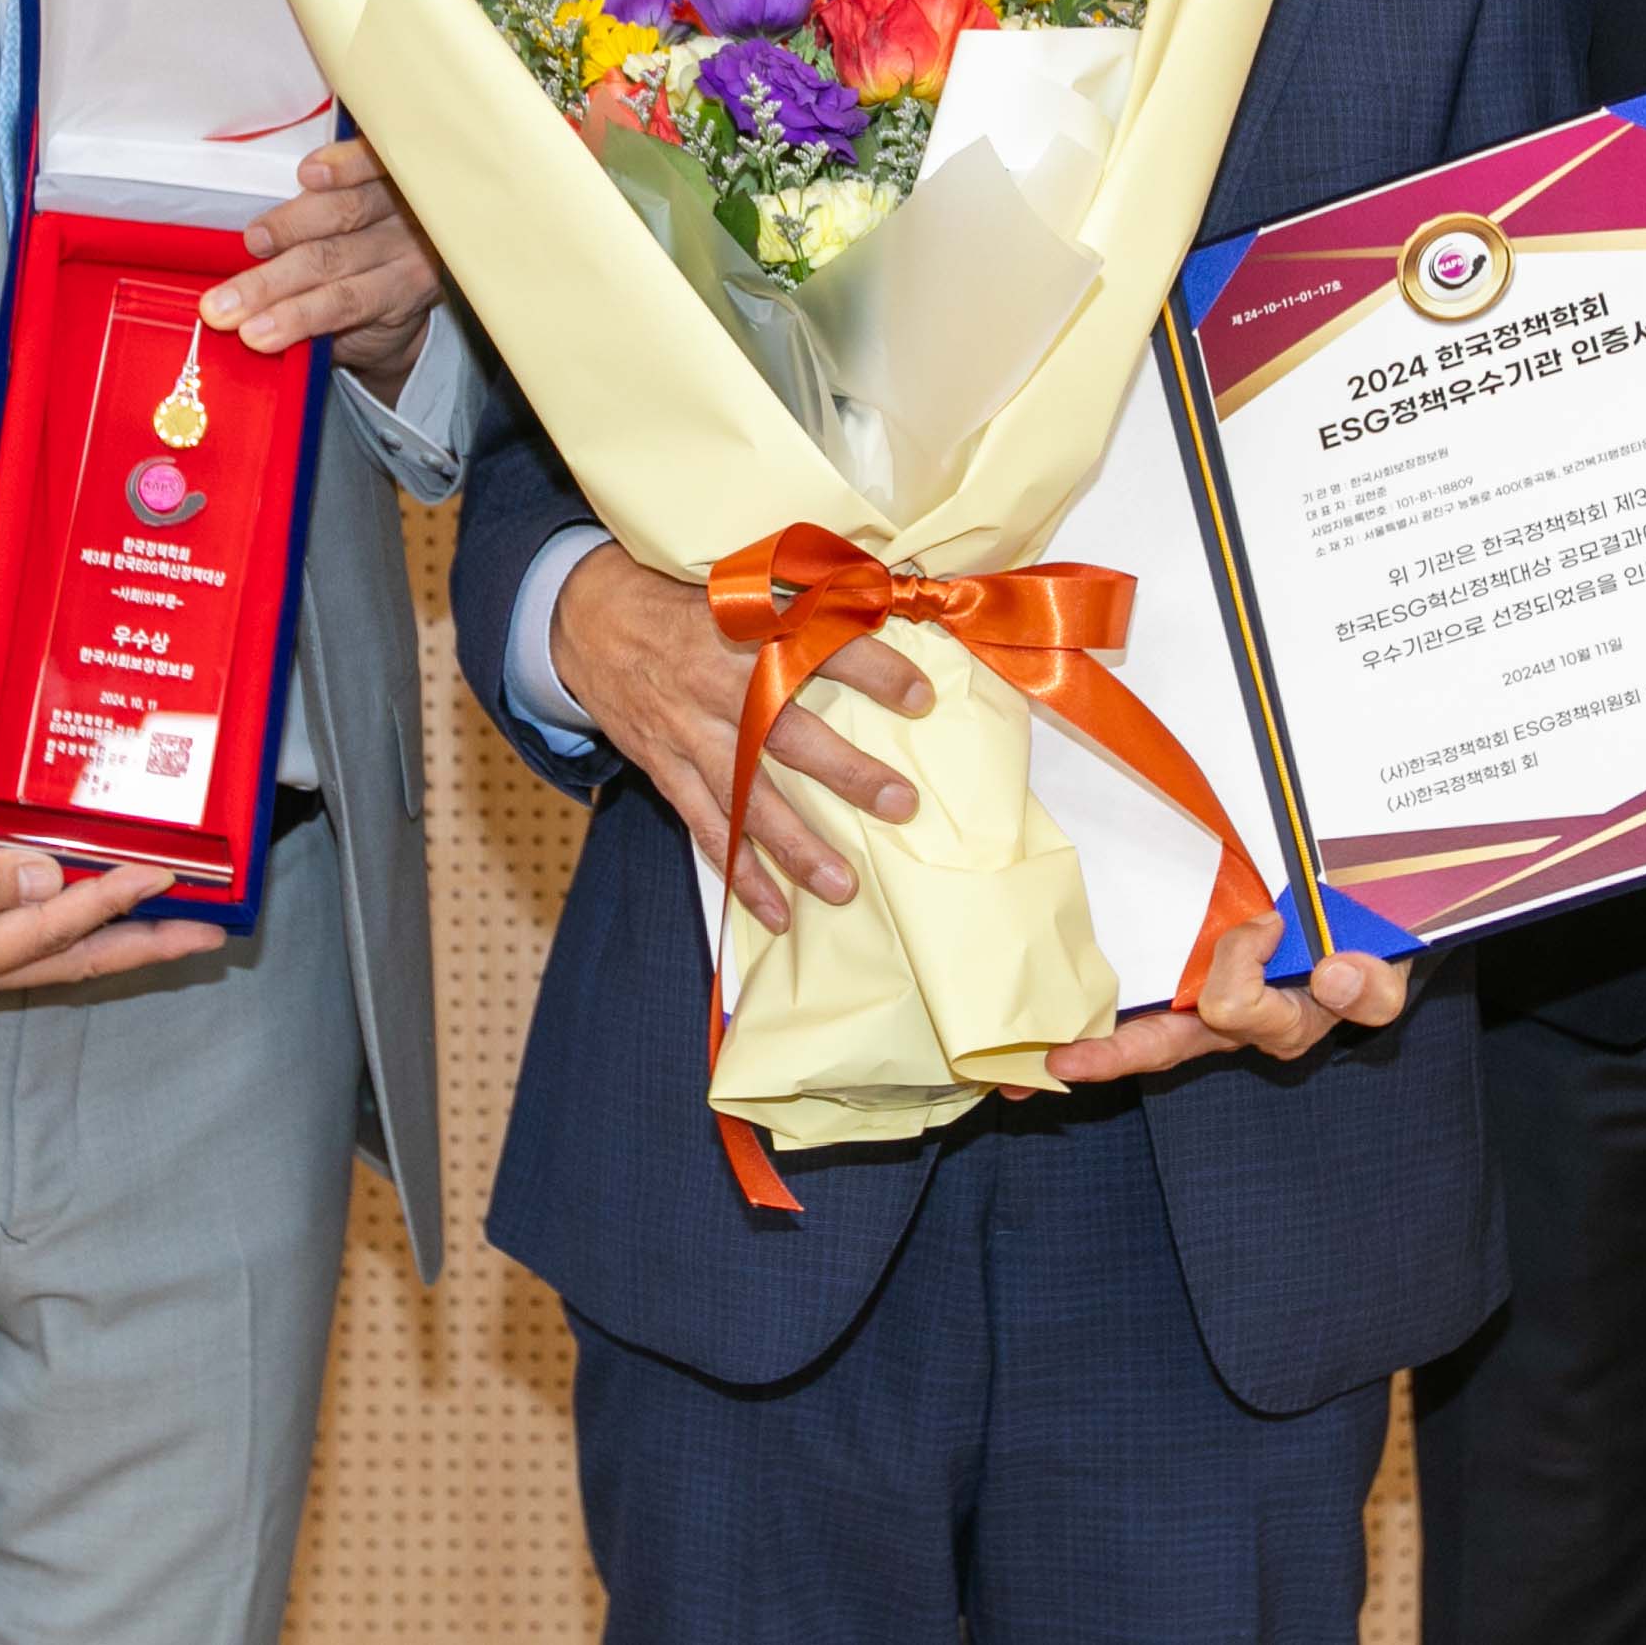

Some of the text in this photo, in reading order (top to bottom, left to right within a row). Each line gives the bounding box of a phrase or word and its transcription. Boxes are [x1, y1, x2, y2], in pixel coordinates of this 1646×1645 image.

[1438, 256, 1464, 272] KAPS
[1346, 291, 1610, 402] 2024 한국정책학회
[1317, 347, 1564, 452] ESG정책우수기관
[1396, 476, 1474, 509] 101-81-18809
[1365, 515, 1419, 540] 서울특별시
[1414, 543, 1476, 579] 기관은
[1481, 500, 1608, 557] 한국정책학회
[113, 552, 227, 588] 한국ESG혁신정책대상
[1334, 555, 1552, 643] 한국ESG혁신정책대상
[1362, 615, 1487, 670] 우수기관으로
[1492, 573, 1618, 629] 선정되었음을
[79, 646, 195, 681] 한국사회보장정보원
[111, 624, 171, 655] 우수상
[1502, 637, 1623, 687] 2024년 10월 11일
[1380, 729, 1509, 784] (사)한국정책학회
[1513, 688, 1641, 741] ESG정책위원회
[1387, 758, 1517, 813] (사)한국정책학회
